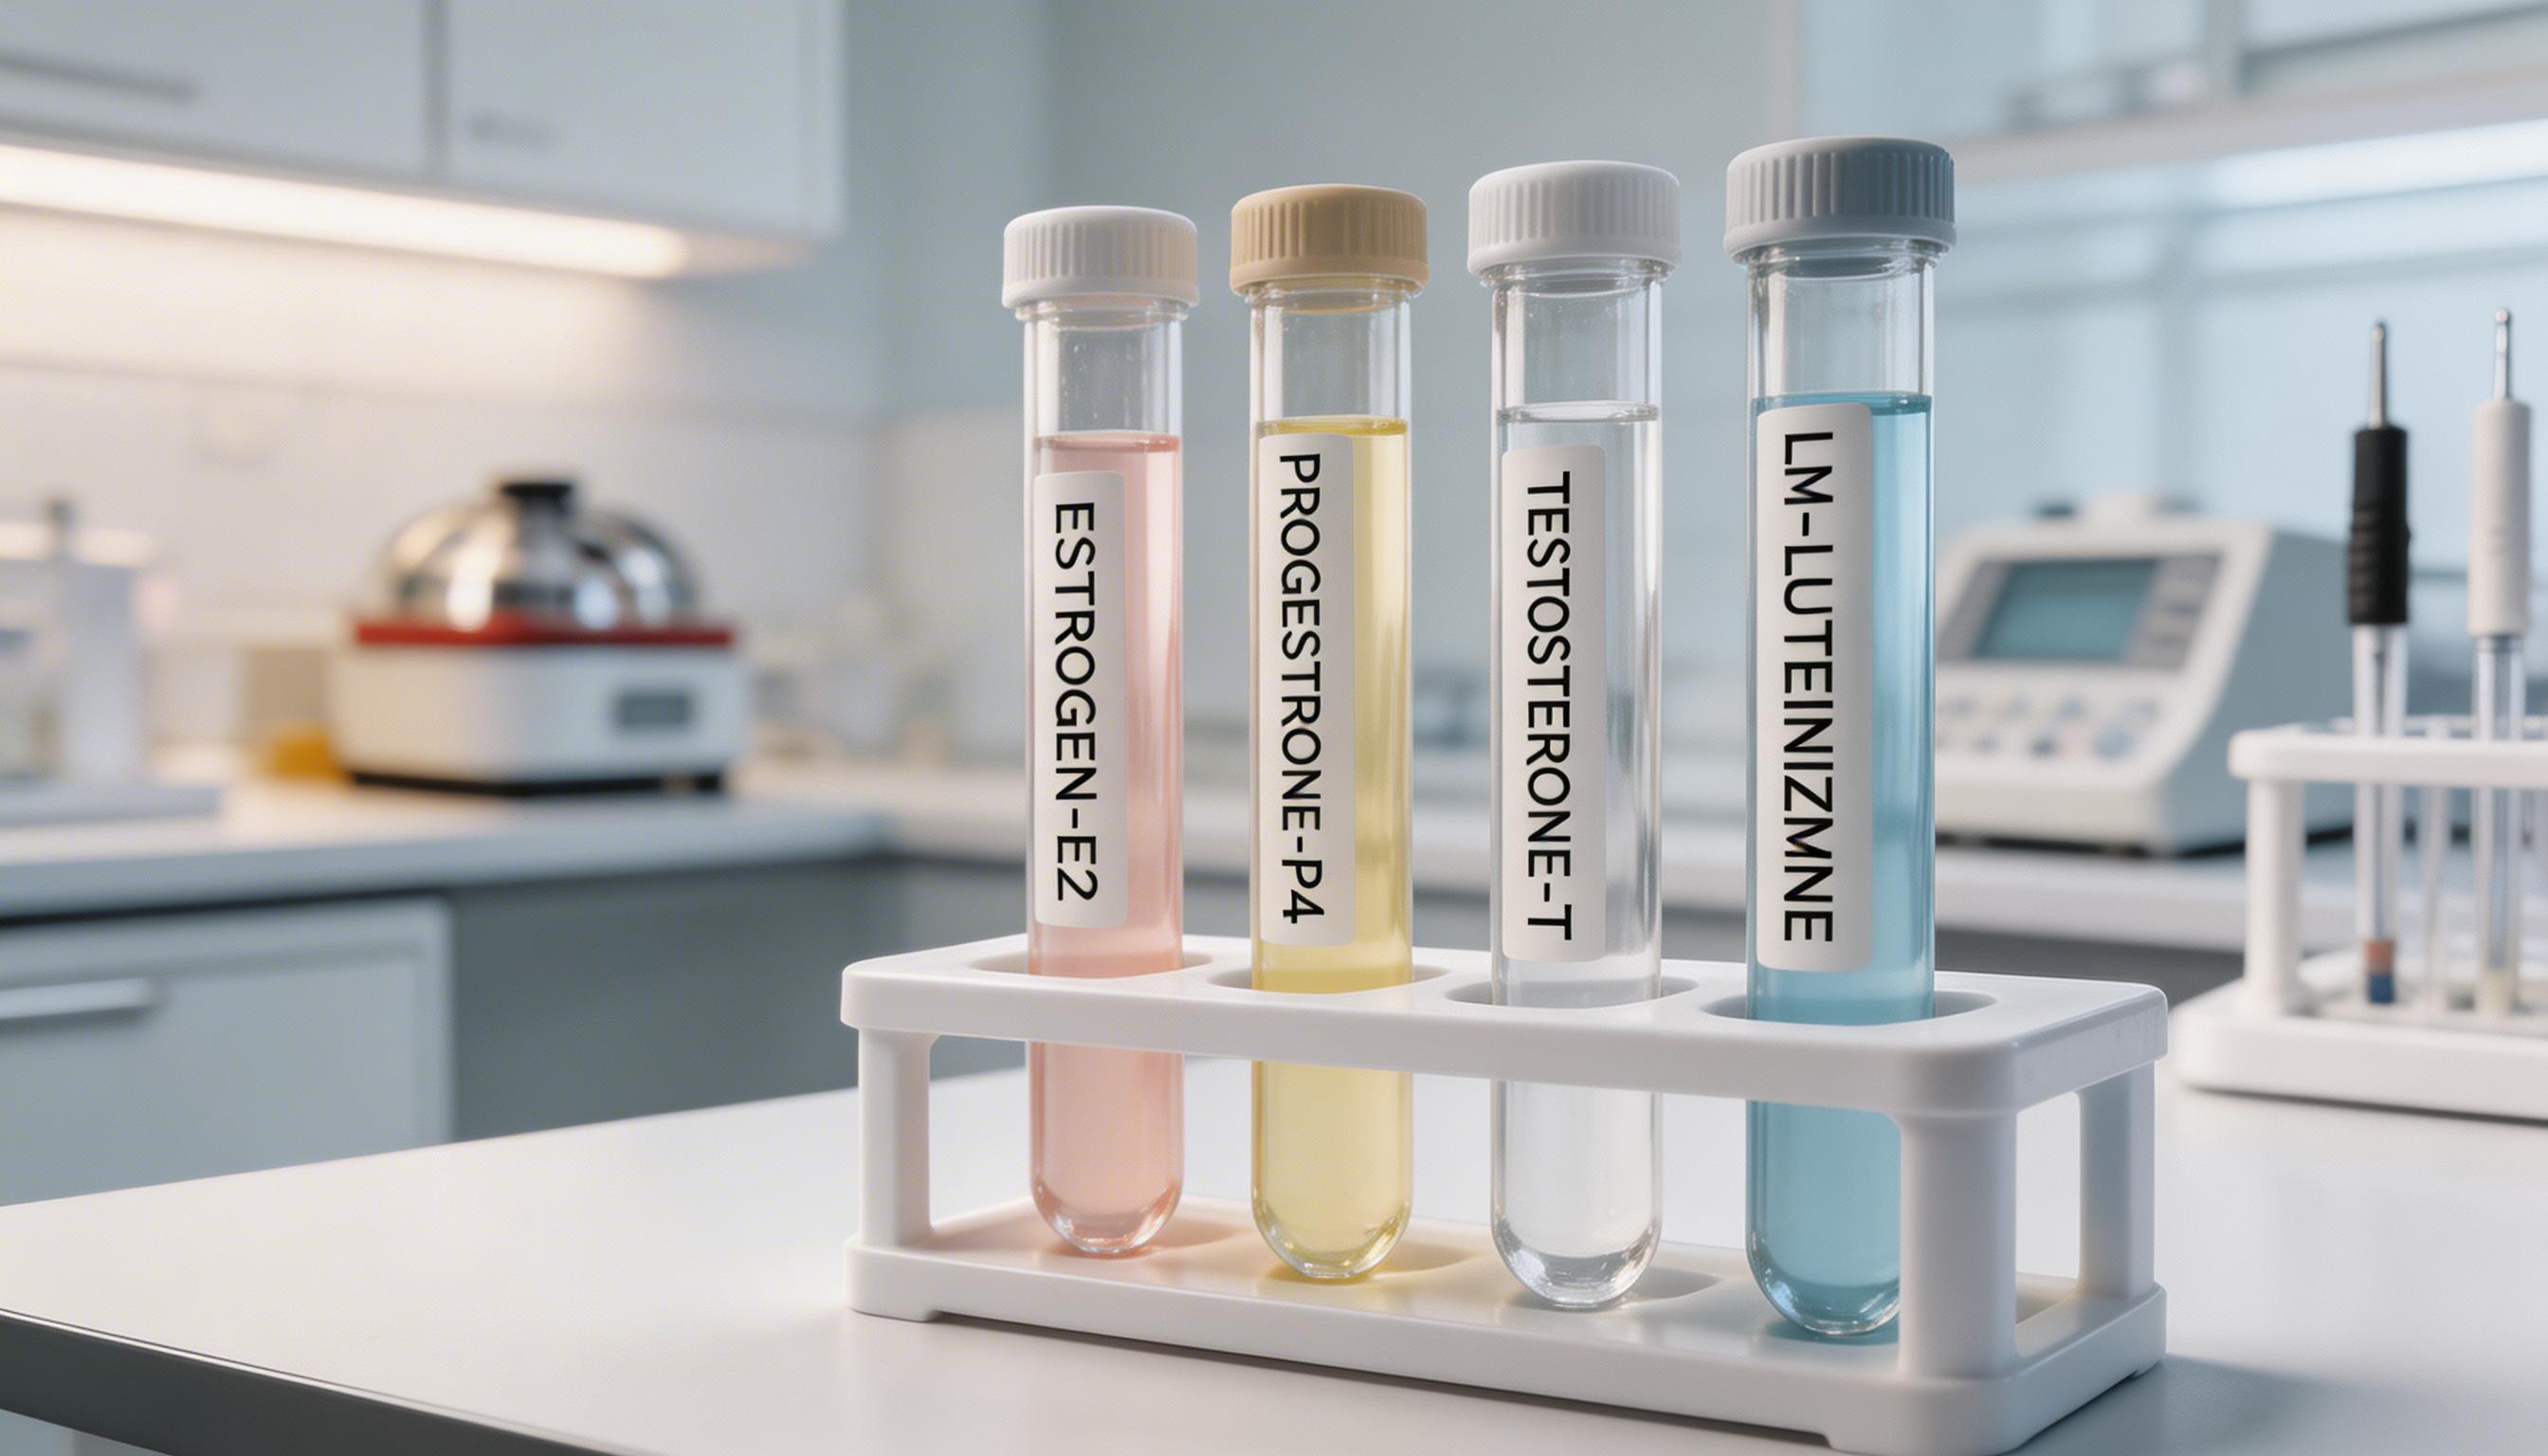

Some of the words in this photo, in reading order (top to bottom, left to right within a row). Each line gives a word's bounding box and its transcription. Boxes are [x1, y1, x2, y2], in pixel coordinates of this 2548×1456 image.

[1055, 501, 1099, 901] ESTROGEN-E2
[1280, 453, 1325, 924] PROGESTRONE-P4
[1526, 471, 1573, 941] TESTOSTERONE-T
[1784, 431, 1834, 942] LM-LUTEINIZMNE
